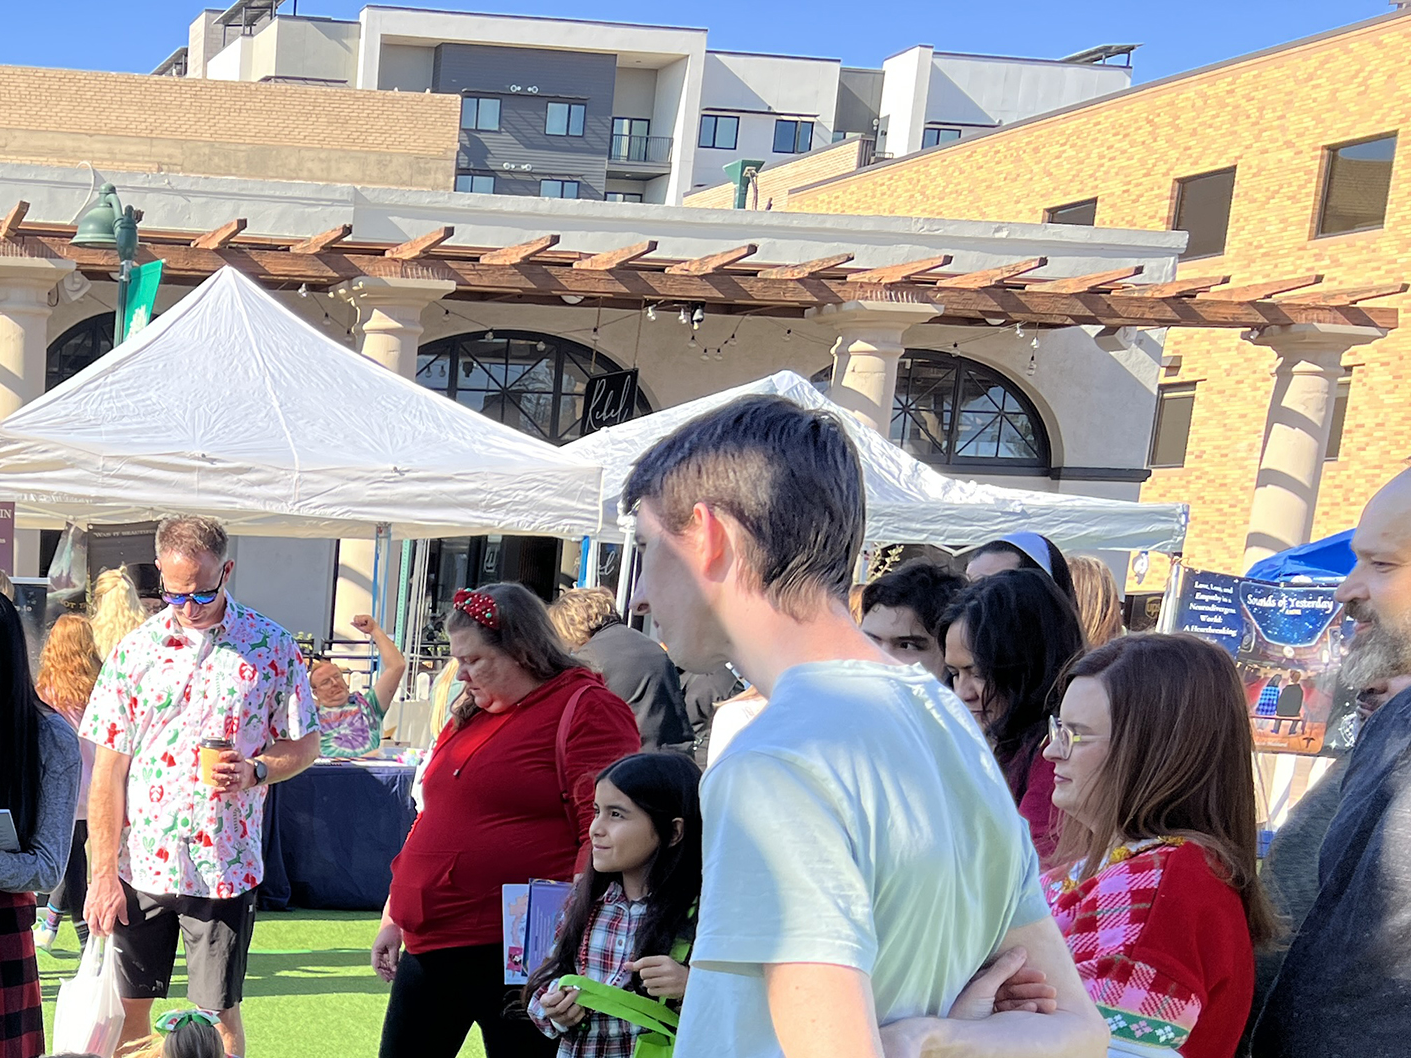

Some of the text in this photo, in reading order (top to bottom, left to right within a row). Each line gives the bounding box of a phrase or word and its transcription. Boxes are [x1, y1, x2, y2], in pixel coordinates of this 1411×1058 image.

[1246, 594, 1334, 614] Sounds of Yesterday
